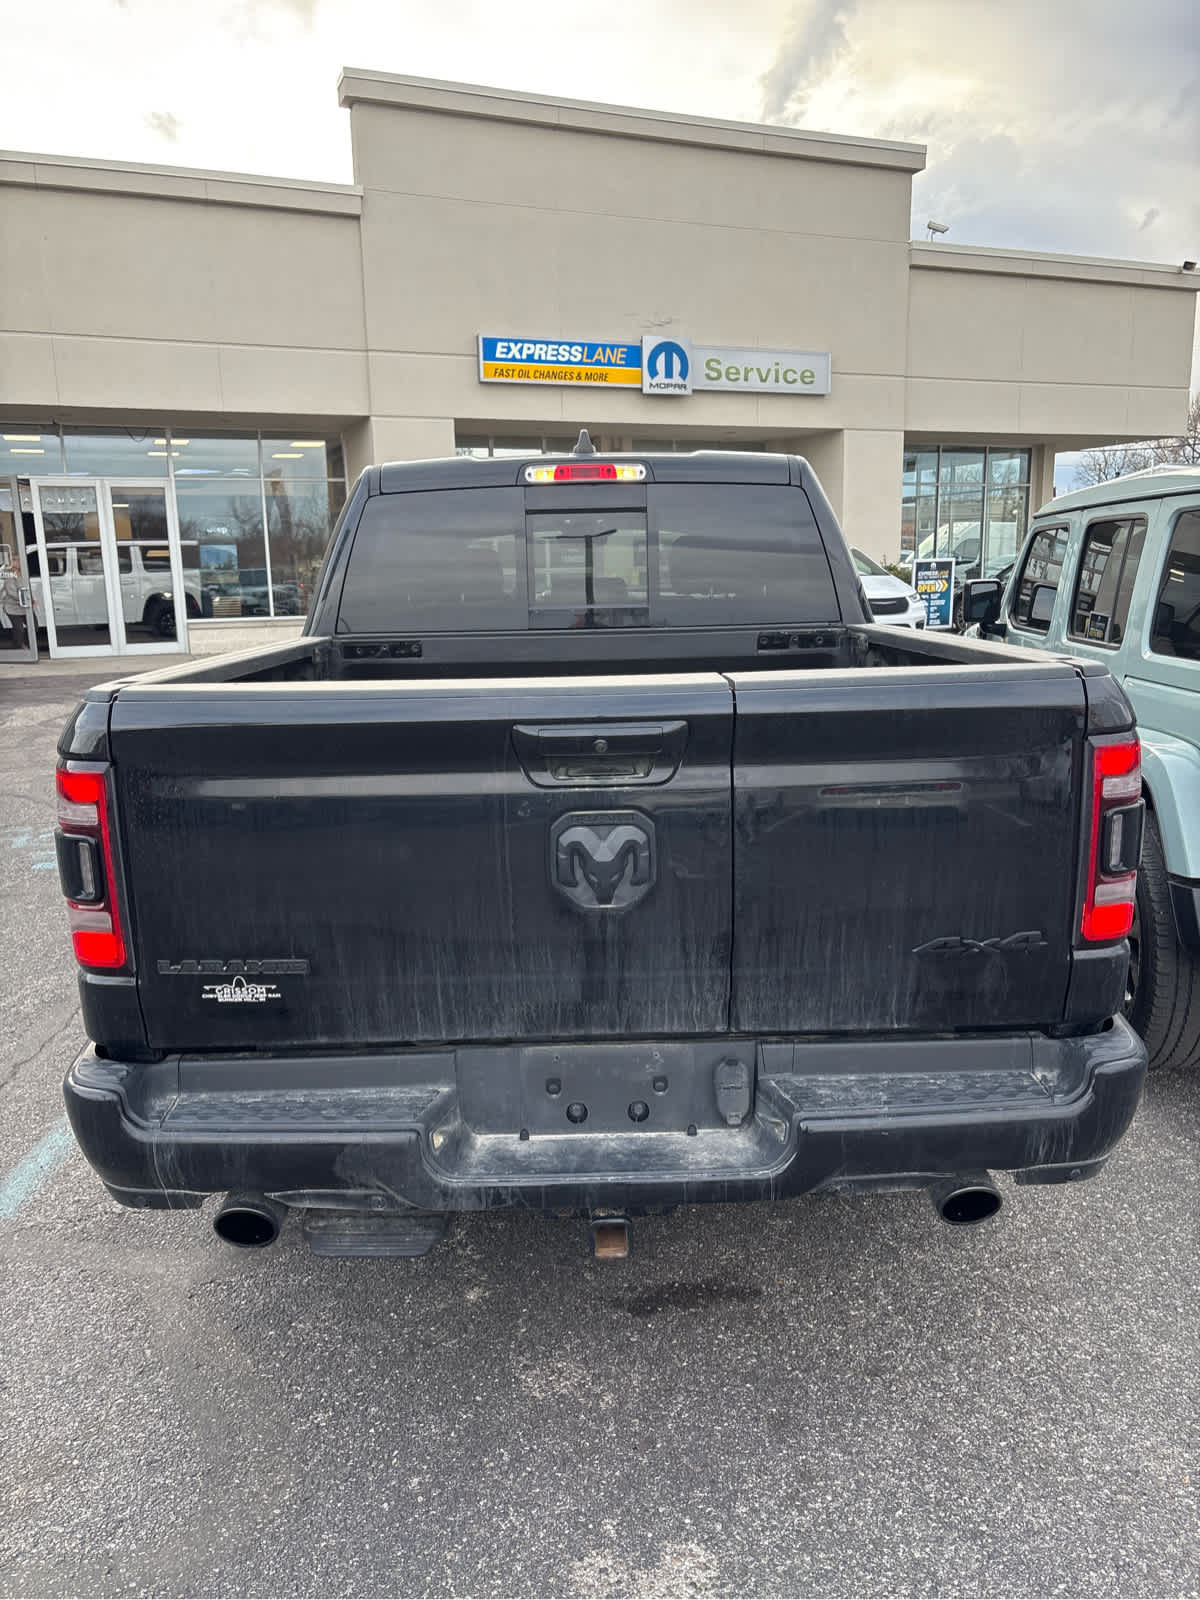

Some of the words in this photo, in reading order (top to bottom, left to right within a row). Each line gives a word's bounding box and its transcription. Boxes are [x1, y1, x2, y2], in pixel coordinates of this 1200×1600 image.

[493, 367, 519, 378] FAST
[517, 368, 532, 379] OIL
[533, 369, 575, 381] CHANGES
[575, 371, 583, 381] &
[584, 371, 609, 382] MORE
[704, 357, 816, 385] Service
[648, 381, 688, 391] MOPAR
[917, 584, 936, 592] OPEN
[156, 959, 311, 975] LARAMIE
[215, 987, 266, 996] GRISSOM
